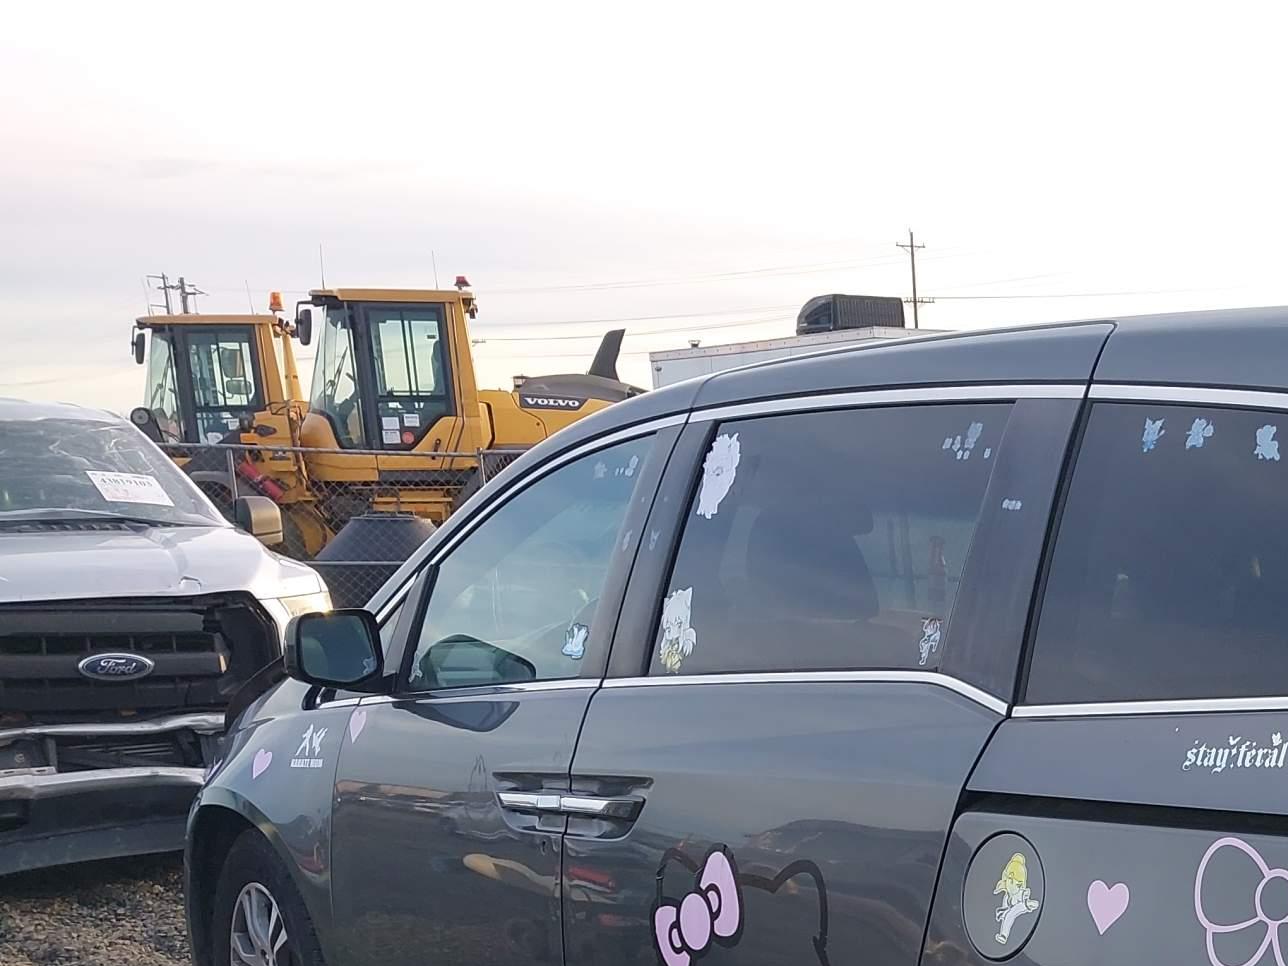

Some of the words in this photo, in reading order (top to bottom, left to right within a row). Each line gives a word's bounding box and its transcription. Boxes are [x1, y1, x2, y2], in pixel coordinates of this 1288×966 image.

[524, 397, 579, 407] VOLVO
[97, 658, 136, 674] Ford
[1182, 741, 1230, 774] stay
